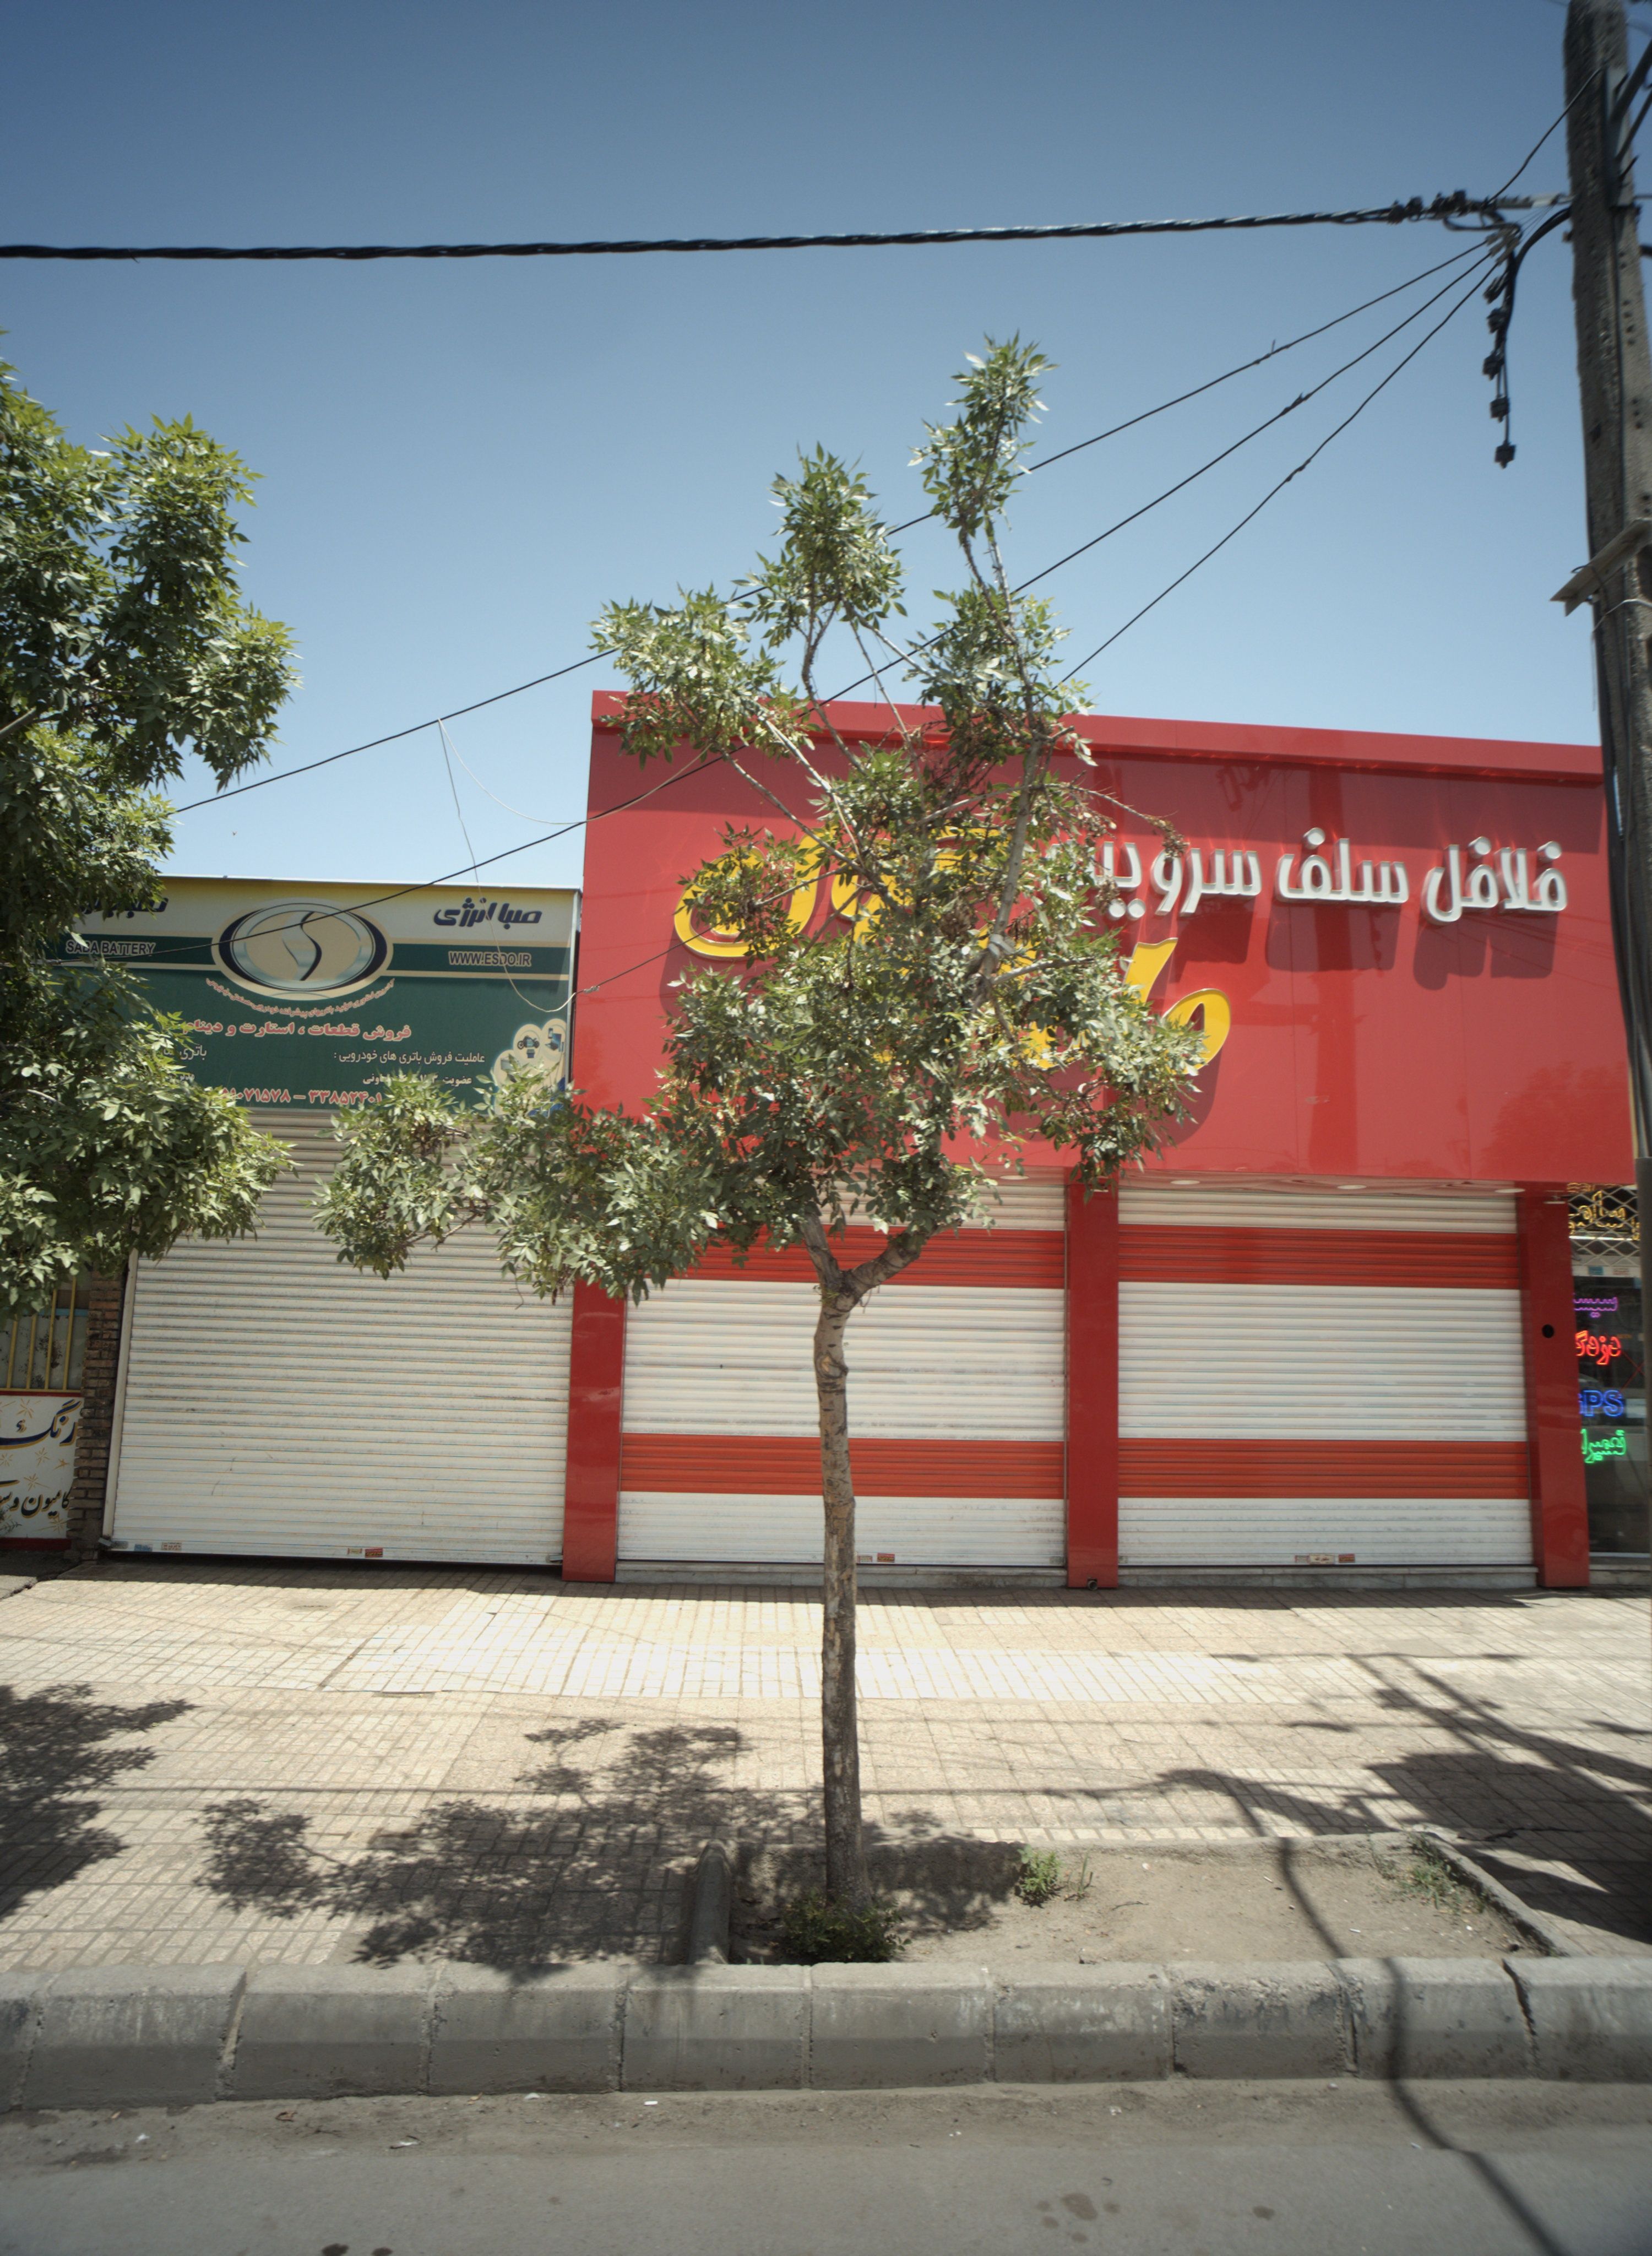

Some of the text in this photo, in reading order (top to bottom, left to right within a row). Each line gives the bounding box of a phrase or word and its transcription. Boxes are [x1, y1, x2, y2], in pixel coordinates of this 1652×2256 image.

[1276, 826, 1409, 904] سلف
[1422, 836, 1568, 925] فلافل
[433, 897, 542, 930] صبا انرژی
[101, 941, 155, 955] BATTERY
[449, 951, 531, 966] WWW.ESDO.IR
[225, 1023, 236, 1036] و
[240, 1022, 295, 1037] استارت
[308, 1023, 360, 1037] قطعات
[362, 1025, 412, 1041] فروش
[339, 1050, 378, 1063] خودرویی
[379, 1050, 397, 1064] های
[399, 1050, 422, 1064] باتری
[424, 1051, 452, 1064] فروش
[455, 1052, 485, 1065] عاملیت
[442, 1075, 472, 1087] عضویت
[1575, 1330, 1622, 1365] دزدگ
[1580, 1428, 1626, 1463] تعمیرا
